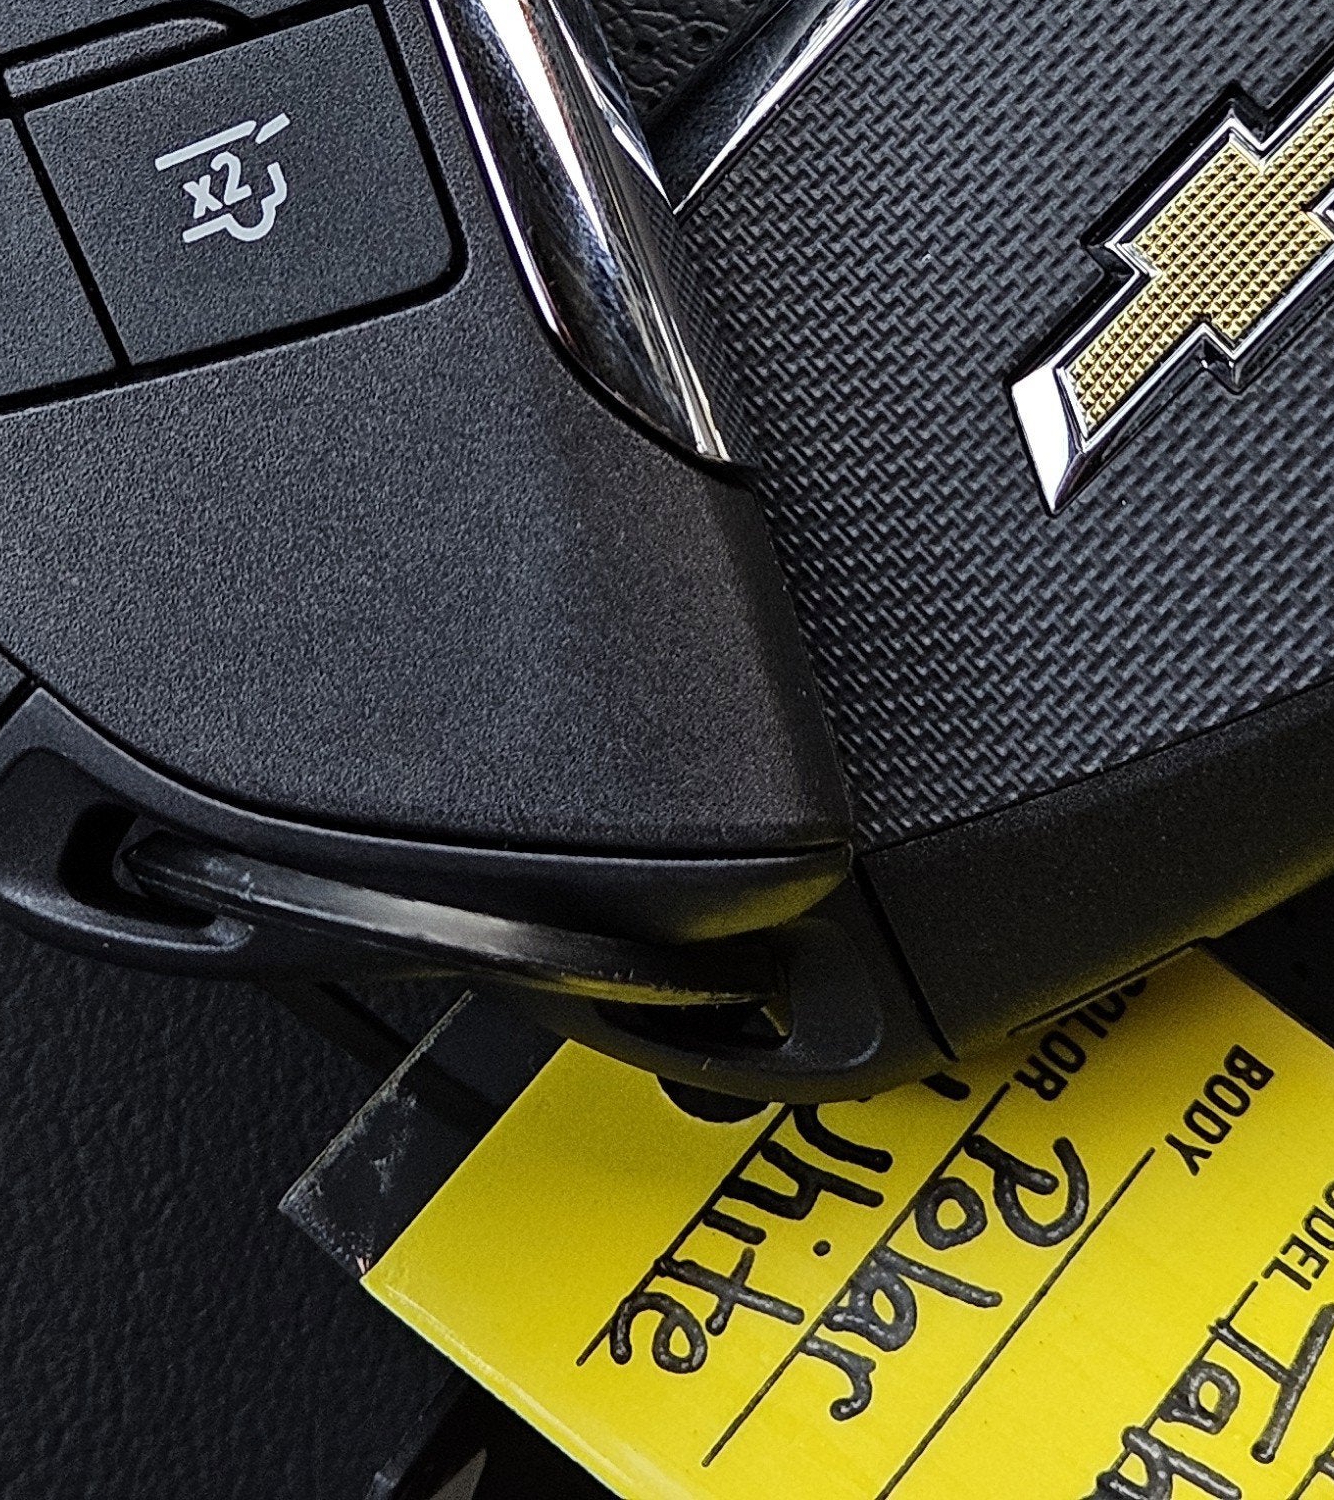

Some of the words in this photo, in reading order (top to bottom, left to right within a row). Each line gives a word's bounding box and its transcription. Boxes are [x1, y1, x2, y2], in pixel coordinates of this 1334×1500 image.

[183, 151, 253, 219] x2
[1165, 1044, 1274, 1176] BODY
[798, 1134, 1090, 1421] Polar
